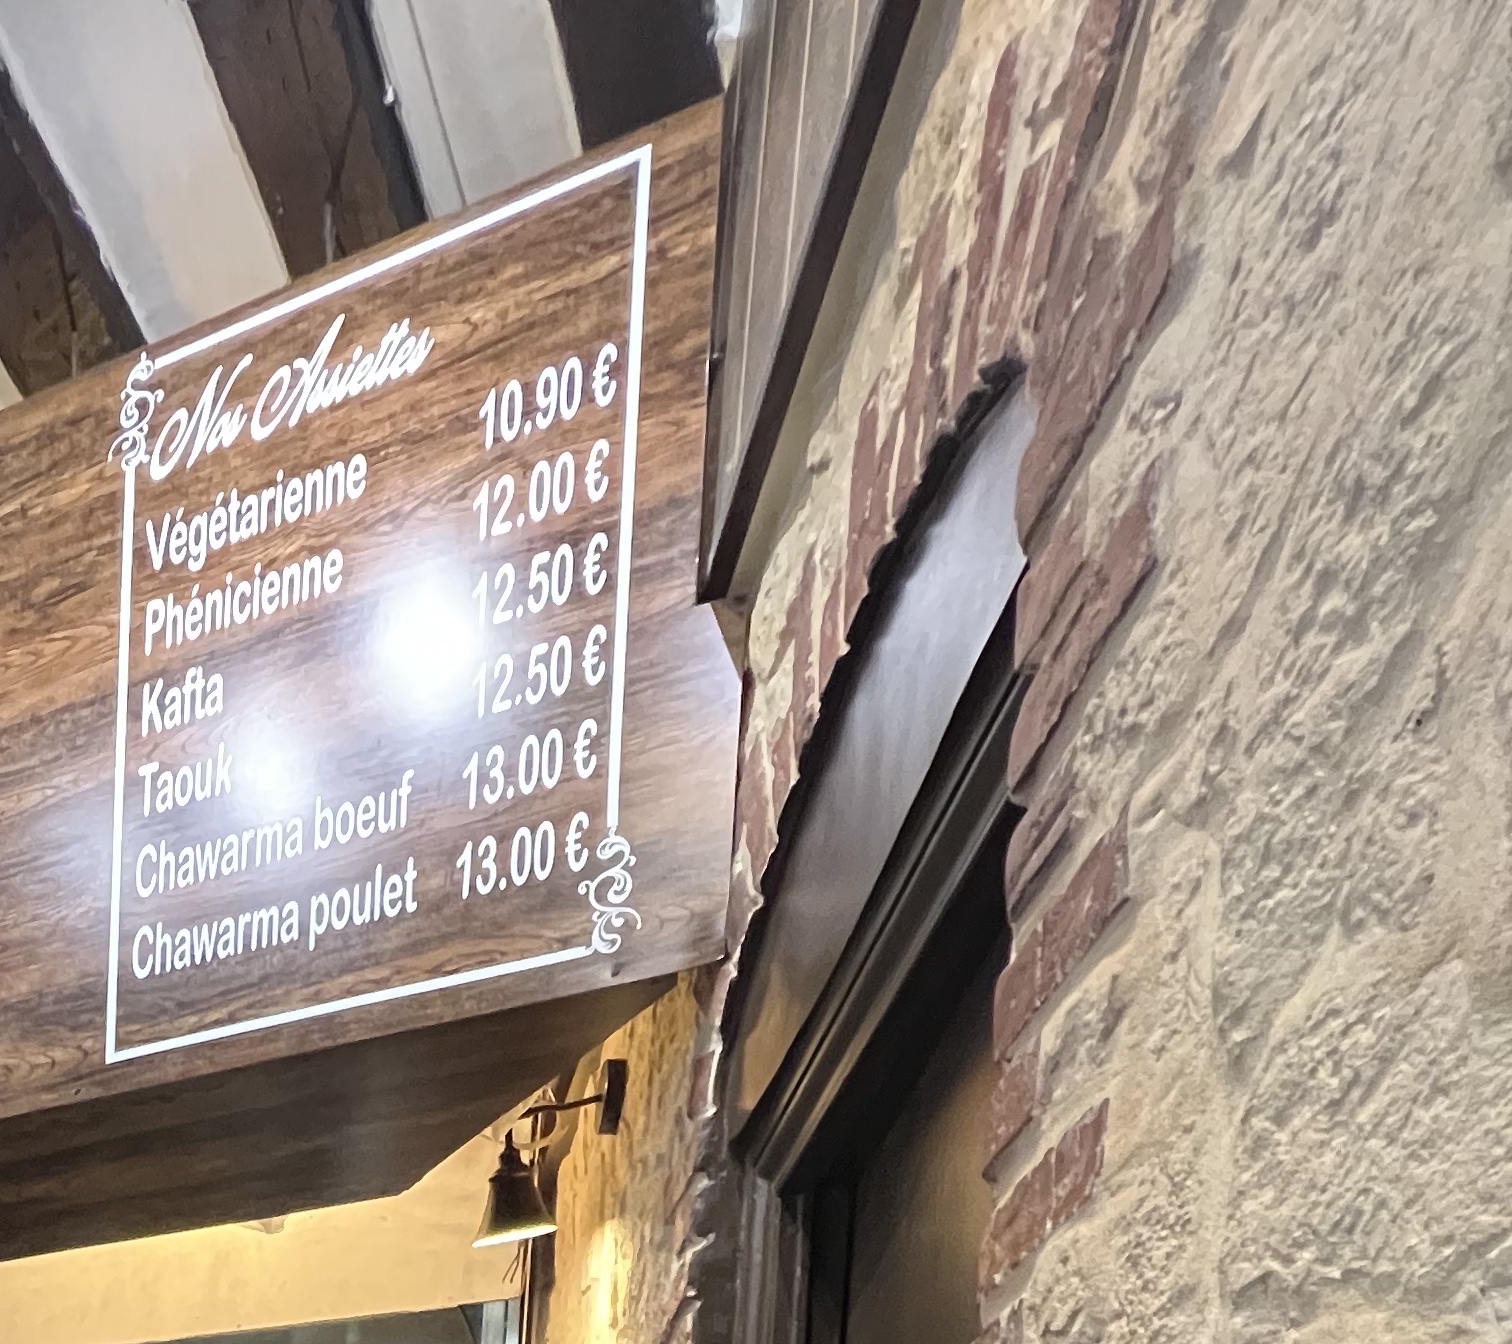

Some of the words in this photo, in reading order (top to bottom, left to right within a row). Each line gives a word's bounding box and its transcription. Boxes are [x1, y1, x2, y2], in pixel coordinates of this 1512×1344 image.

[145, 452, 368, 573] Végétarienne
[478, 355, 584, 450] 10.90
[591, 342, 619, 408] €
[149, 352, 254, 482] Nos
[249, 312, 436, 442] Assiettes
[140, 665, 224, 738] Kafta
[471, 542, 574, 630] 12.50
[583, 531, 610, 596] €
[143, 548, 344, 657] Phénicienne
[472, 450, 576, 542] 12.00
[584, 437, 610, 503] €
[134, 812, 303, 899] Chawarma
[314, 768, 415, 850] boeuf
[461, 727, 564, 810] 13.00
[572, 718, 598, 780] €
[137, 741, 233, 818] Taouk
[472, 634, 573, 718] 12.50
[581, 624, 608, 687] €
[131, 900, 299, 980] Chawarma
[308, 855, 418, 952] poulet
[456, 820, 556, 900] 13.00
[564, 811, 590, 873] €
